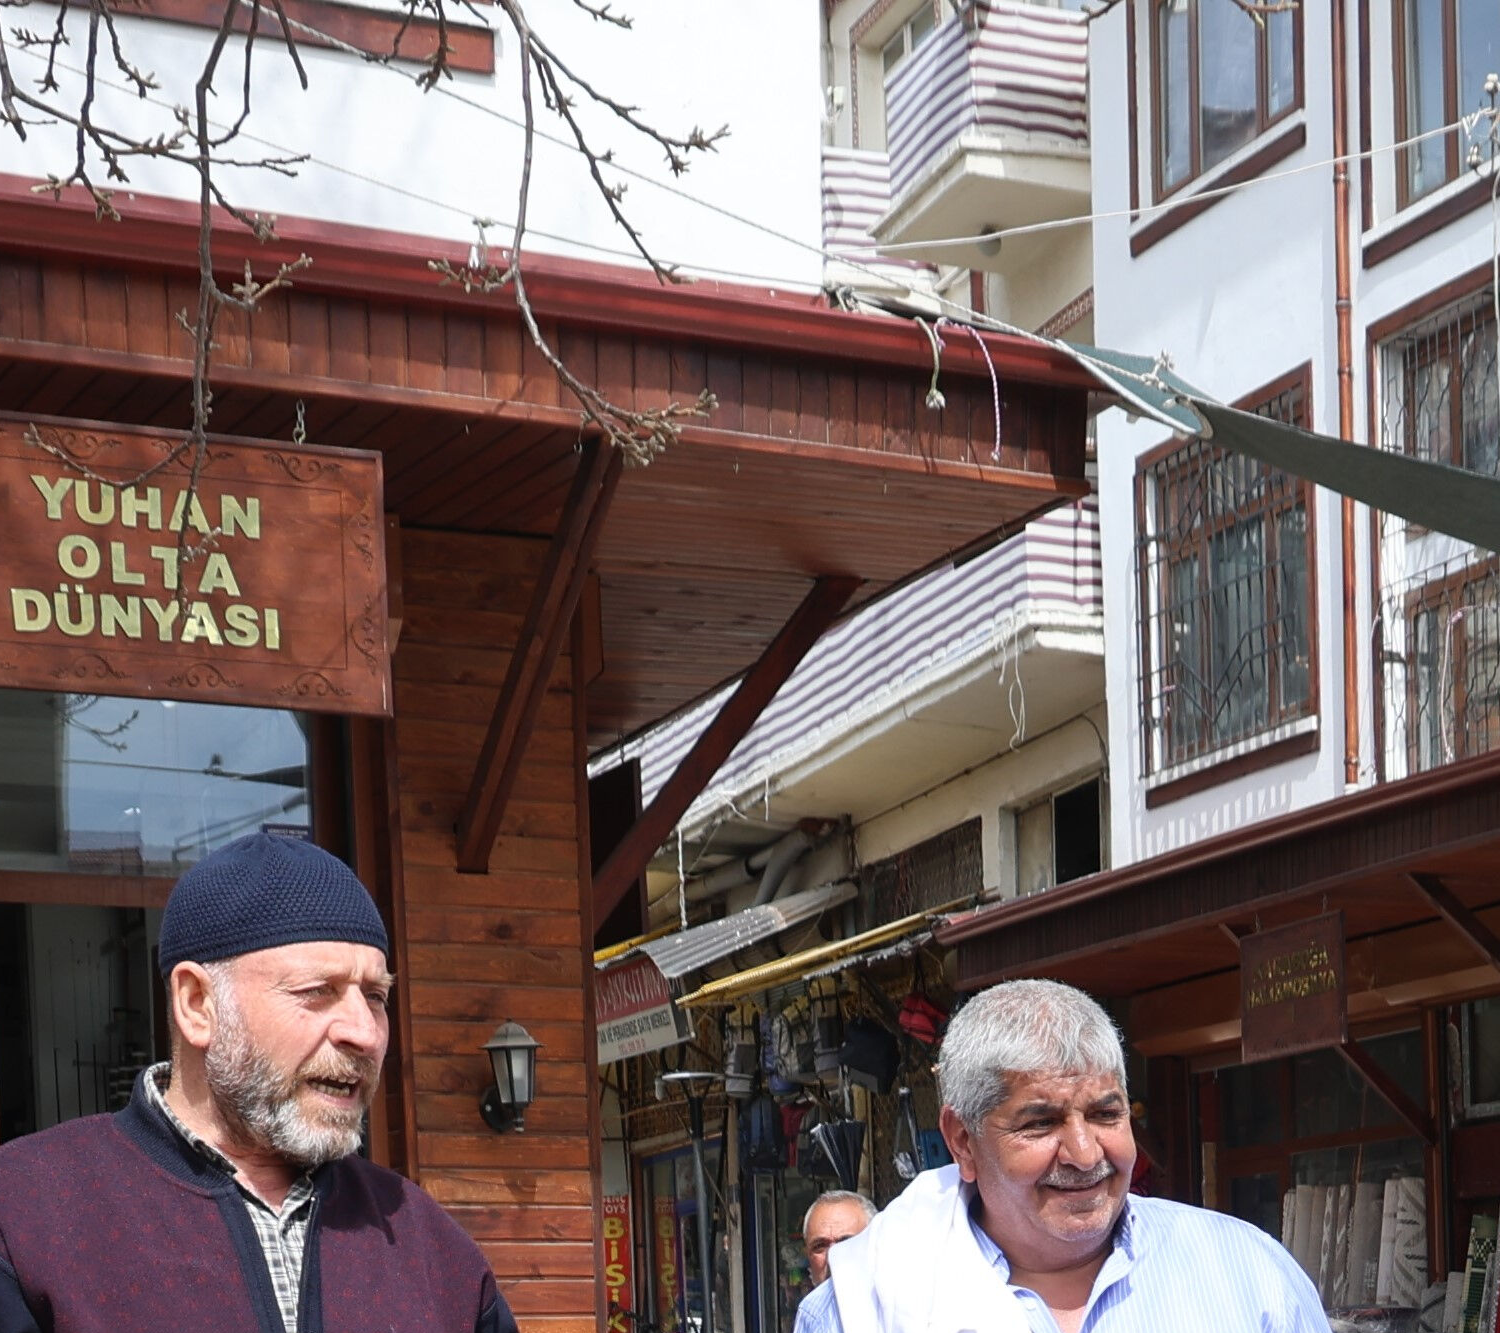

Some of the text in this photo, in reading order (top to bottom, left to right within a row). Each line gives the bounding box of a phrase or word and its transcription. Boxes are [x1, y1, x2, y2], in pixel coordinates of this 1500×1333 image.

[30, 474, 262, 541] YUHAN
[58, 533, 241, 598] OLTA
[10, 582, 282, 651] DÜNYASI
